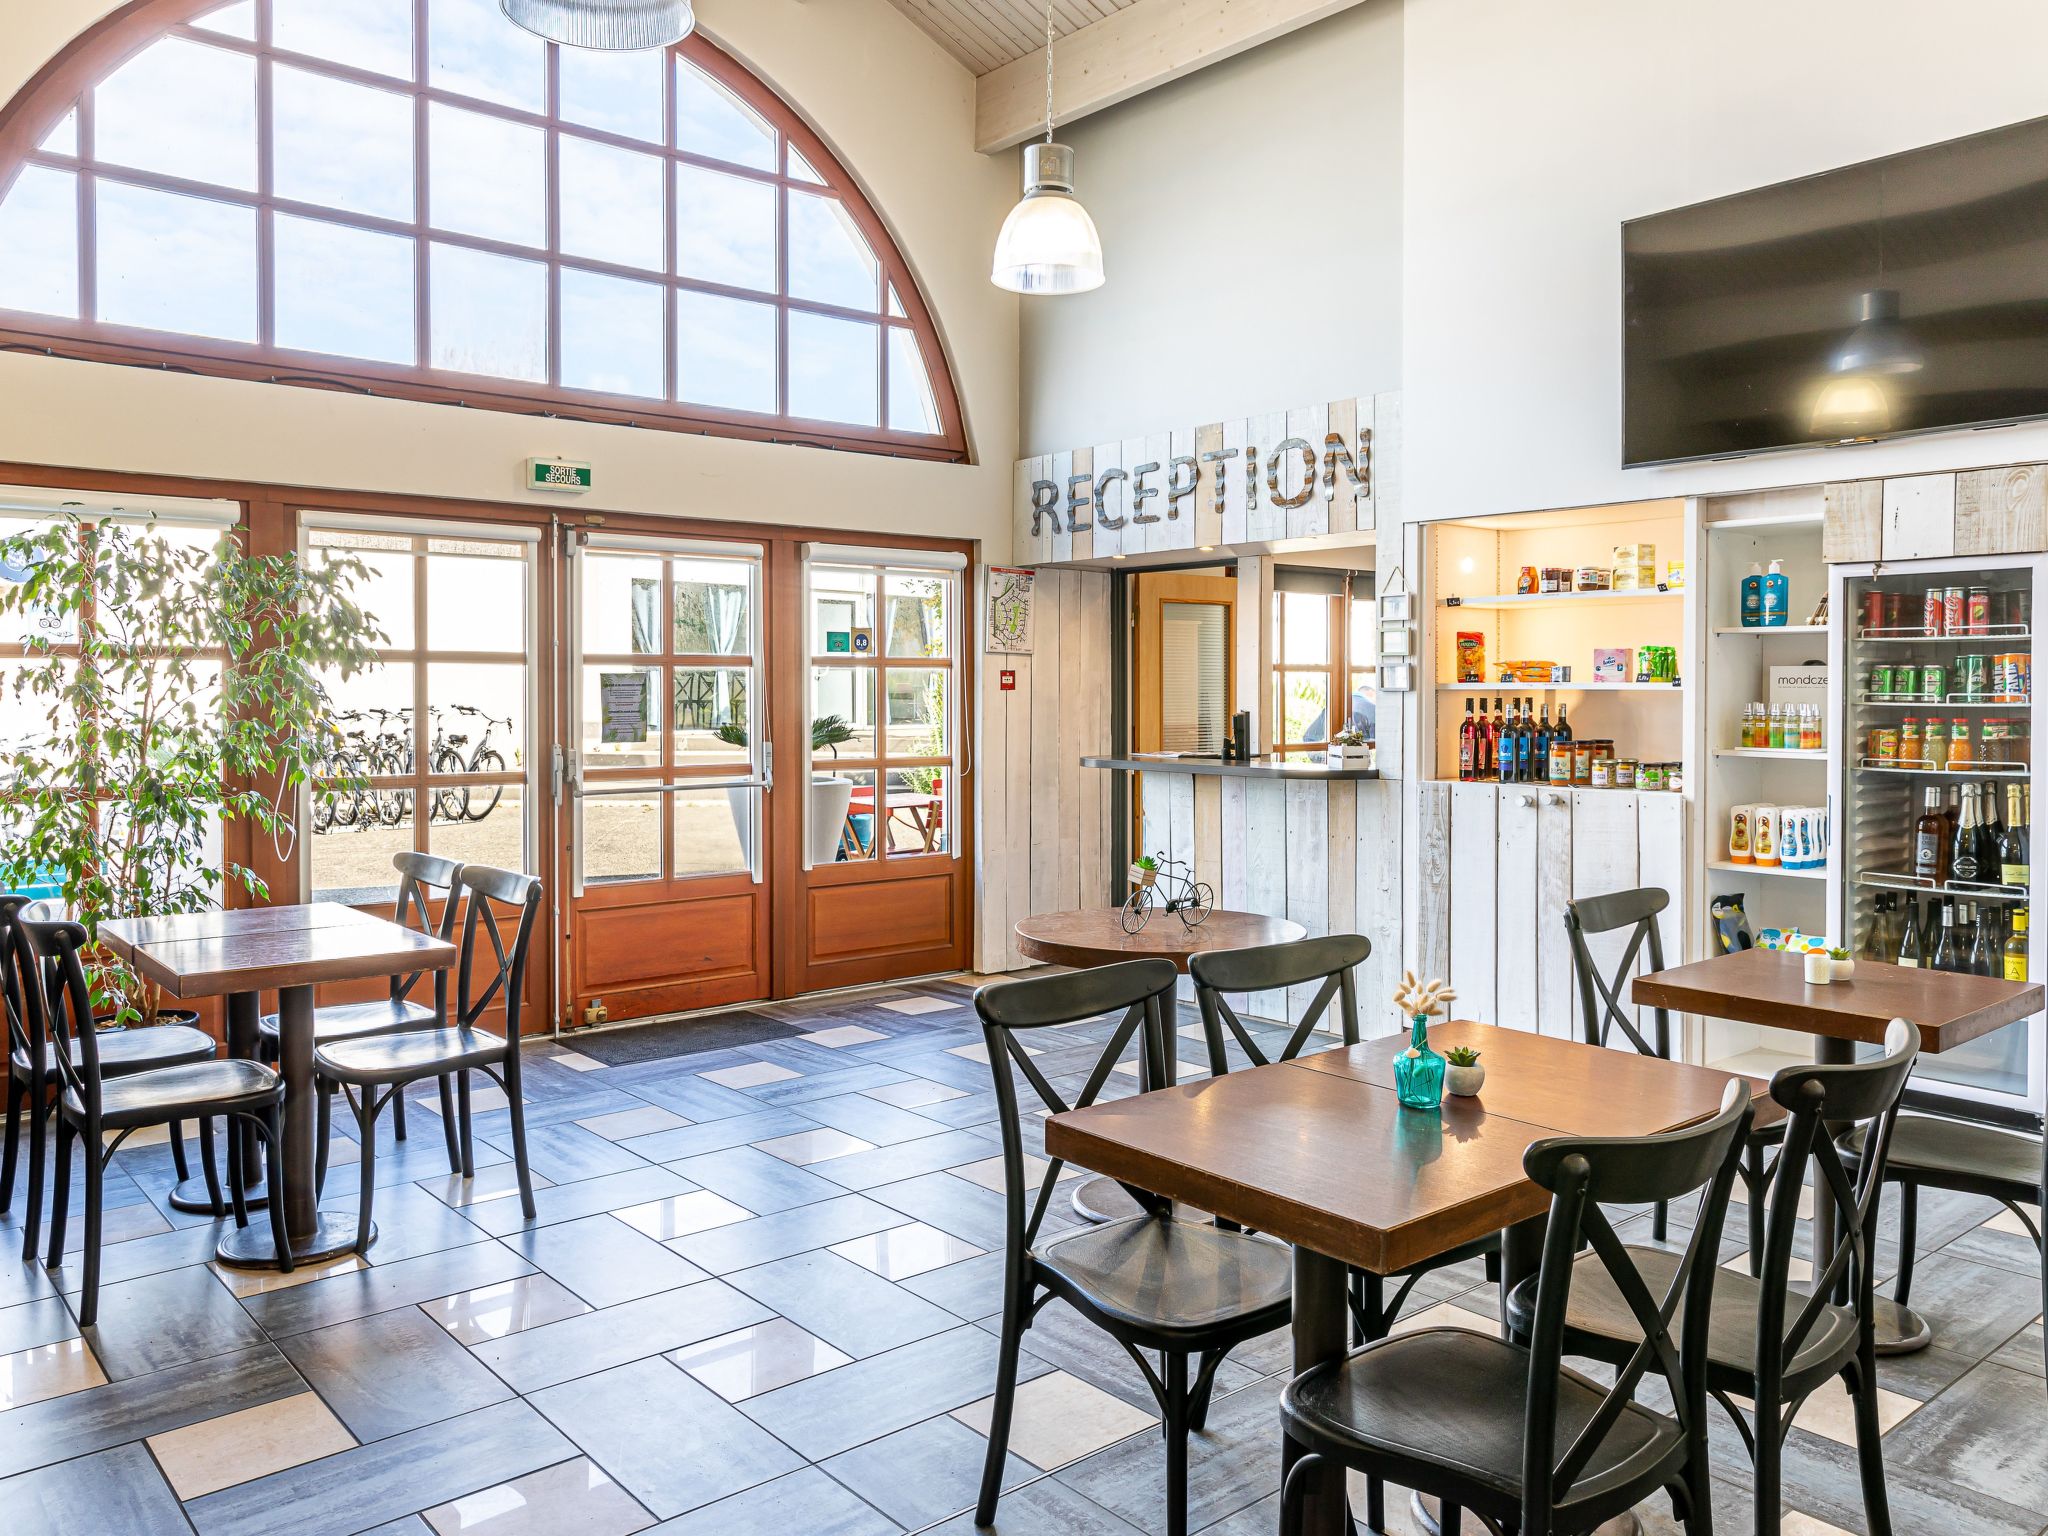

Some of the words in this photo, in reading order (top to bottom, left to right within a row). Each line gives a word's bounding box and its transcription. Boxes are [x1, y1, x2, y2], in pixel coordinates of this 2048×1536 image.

[550, 466, 577, 477] SORTIE
[546, 474, 581, 485] SECOURS
[1031, 428, 1373, 537] RECEPTION
